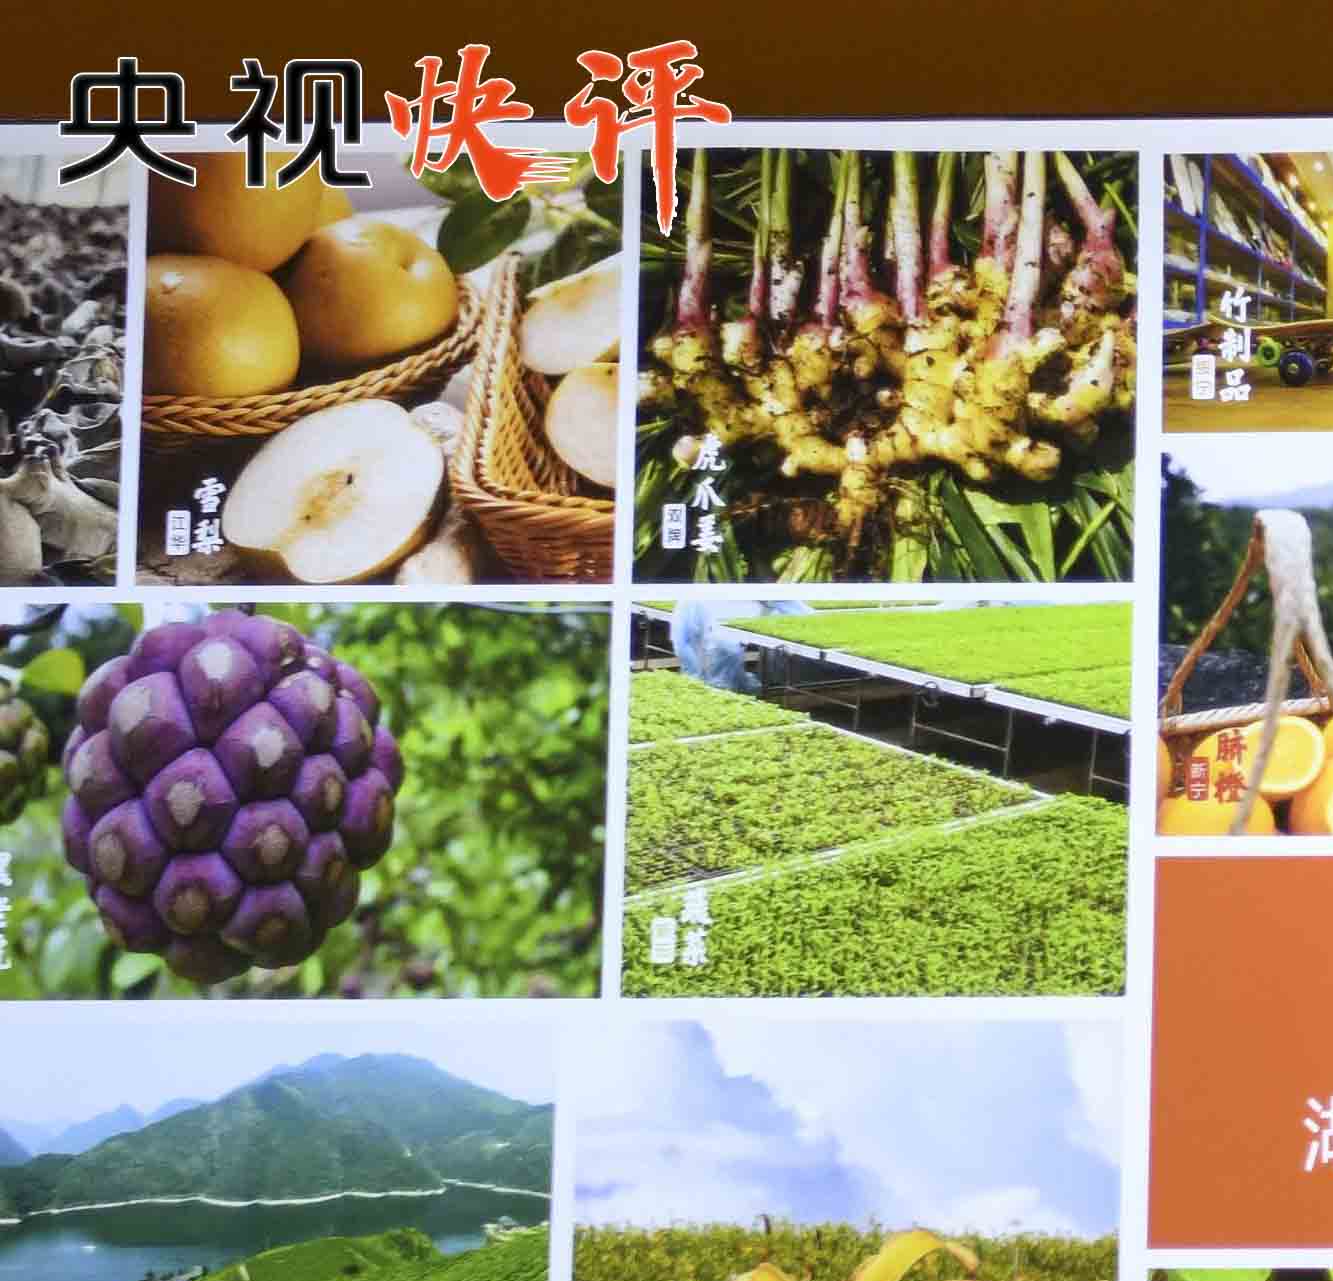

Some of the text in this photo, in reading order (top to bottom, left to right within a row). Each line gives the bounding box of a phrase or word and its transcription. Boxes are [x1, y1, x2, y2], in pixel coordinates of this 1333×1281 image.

[1217, 286, 1252, 401] 竹制品
[193, 477, 227, 555] 雪梨
[690, 433, 727, 553] 虎爪姜
